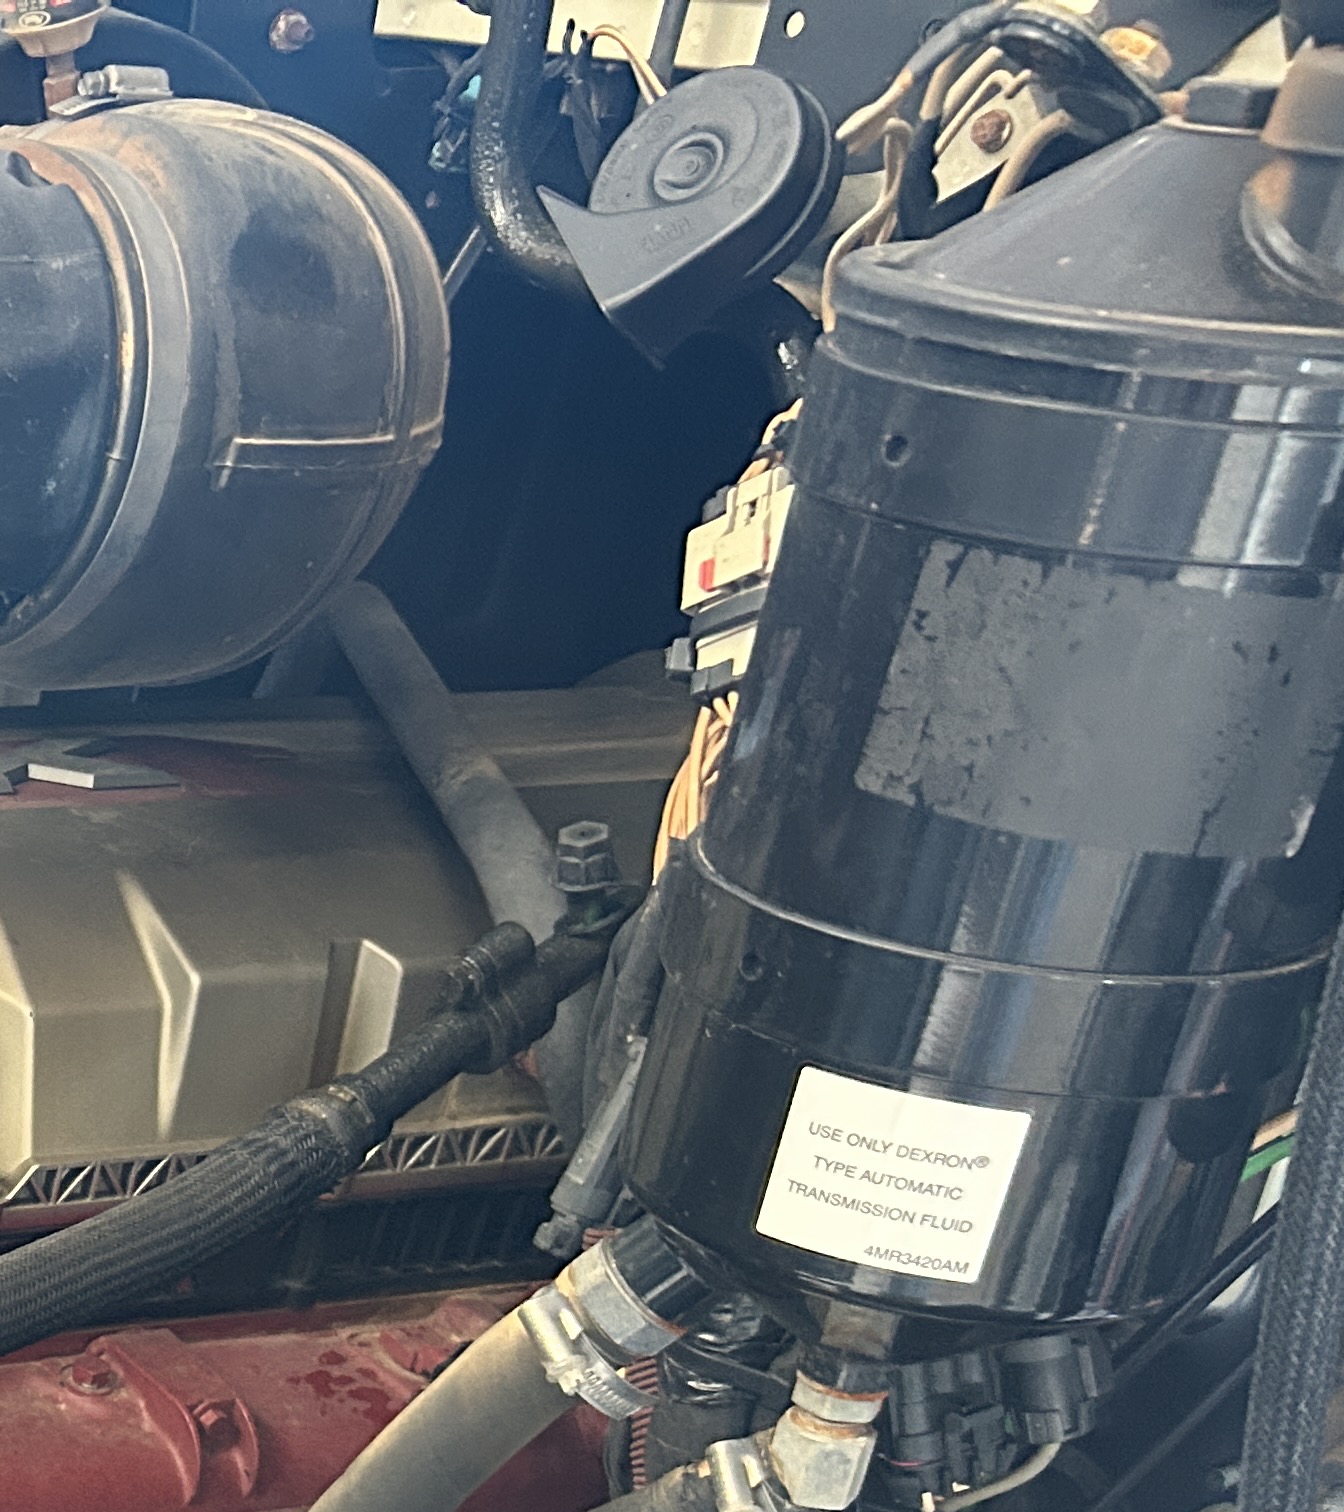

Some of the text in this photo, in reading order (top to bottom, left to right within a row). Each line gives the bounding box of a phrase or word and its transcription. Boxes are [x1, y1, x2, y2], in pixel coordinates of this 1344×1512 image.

[808, 1121, 844, 1143] USE
[846, 1132, 894, 1155] ONLY
[813, 1154, 964, 1202] TYPE AUTOMATIC
[787, 1178, 974, 1234] TRANSMISSION FLUID
[863, 1245, 971, 1275] 4MR3420AM
